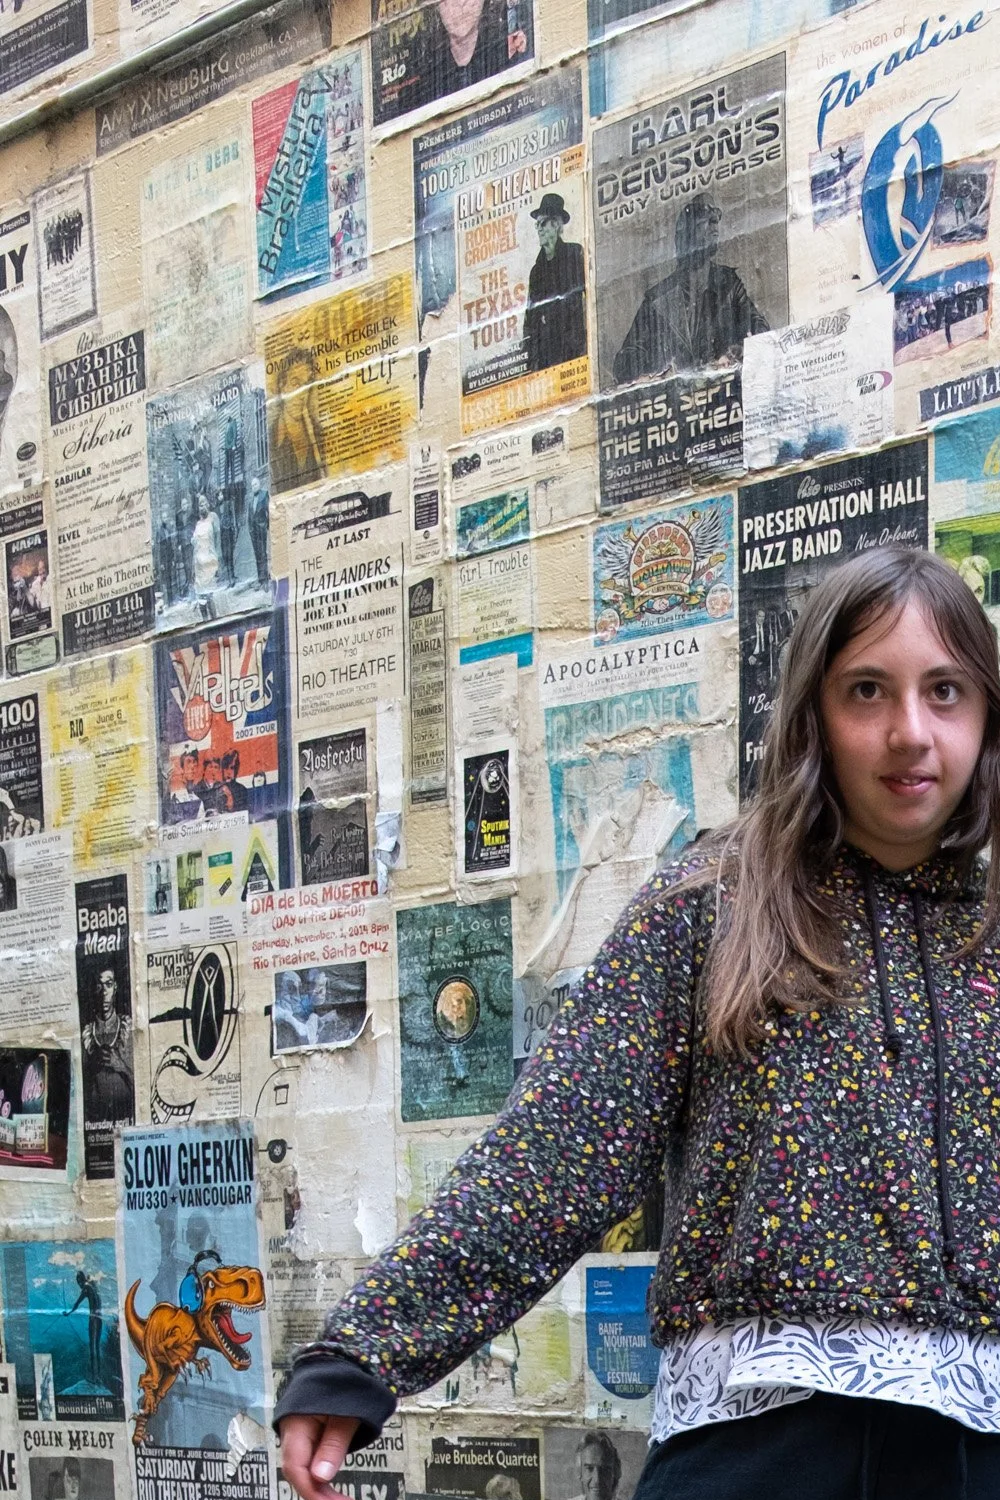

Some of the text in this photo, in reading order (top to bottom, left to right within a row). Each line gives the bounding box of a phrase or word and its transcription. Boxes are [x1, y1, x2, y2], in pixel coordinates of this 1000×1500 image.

[563, 151, 582, 163] SANTA
[458, 155, 561, 220] RIO THEATER
[599, 144, 782, 224] TINY UNIVERSE
[480, 266, 508, 294] THE
[463, 283, 526, 328] TEXAS
[470, 314, 518, 350] TOUR
[743, 476, 925, 543] PRESERVATION HALL
[58, 530, 80, 544] ELVEL
[327, 528, 371, 550] AT LAST
[742, 528, 842, 575] JAZZ BAND
[301, 556, 323, 573] THE
[459, 562, 483, 586] Girl
[488, 551, 529, 576] Trouble
[66, 563, 150, 600] At the Rio Theatre
[303, 601, 349, 622] JOE ELY
[302, 625, 394, 657] SATURDAY JULY 6TH
[412, 638, 442, 657] MARIZA
[302, 655, 396, 691] RIO THEATRE
[235, 723, 276, 739] 2002 TOUR
[483, 833, 507, 847] MANIA
[78, 904, 128, 934] Baaba
[398, 915, 510, 943] MAYBE LOGIC
[84, 933, 122, 956] Maal
[253, 957, 270, 970] Rio
[322, 945, 357, 960] Santa
[359, 940, 389, 953] Cruz
[146, 951, 194, 967] Burning
[124, 1138, 255, 1190] SLOW GHERKIN
[126, 1185, 251, 1211] MU330 VANCOUGAR
[598, 1322, 623, 1336] BANFF
[604, 1335, 646, 1348] MOUNTAIN
[607, 1371, 642, 1384] FESTIVAL
[57, 1404, 96, 1415] mountain
[23, 1429, 115, 1451] COLIN MELOY
[203, 1483, 269, 1500] 1205 SOQUEL AVE
